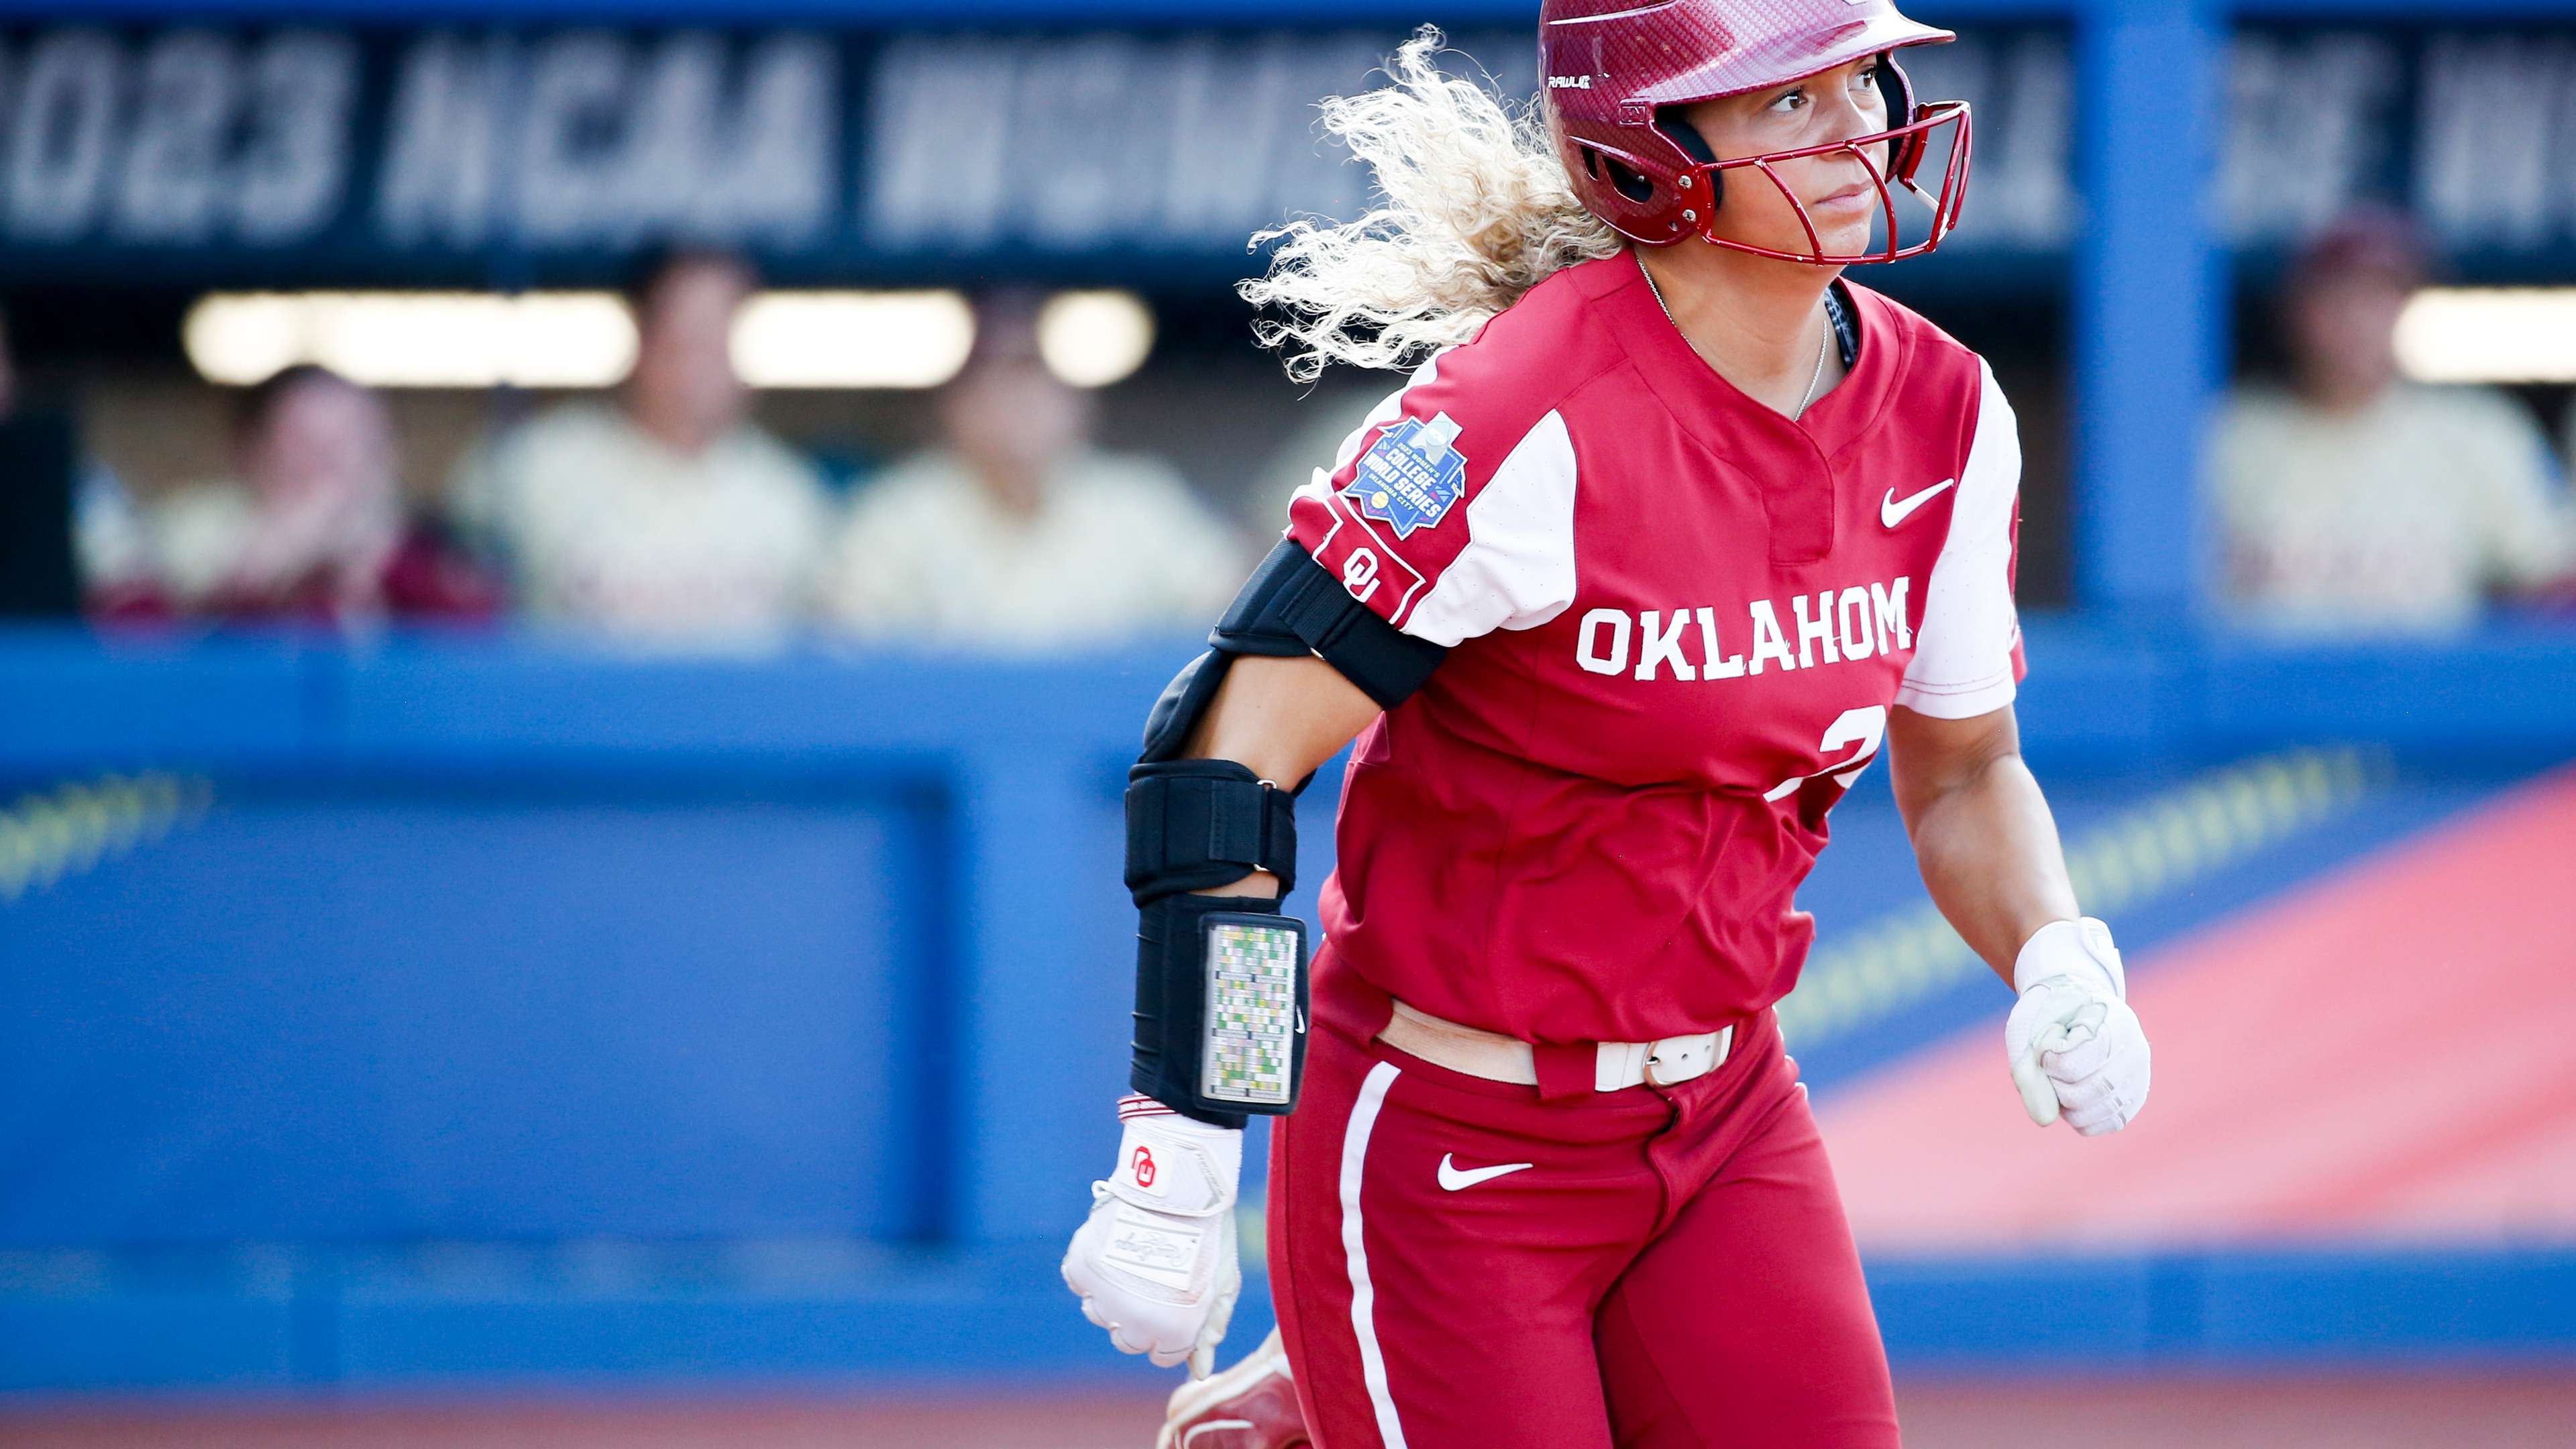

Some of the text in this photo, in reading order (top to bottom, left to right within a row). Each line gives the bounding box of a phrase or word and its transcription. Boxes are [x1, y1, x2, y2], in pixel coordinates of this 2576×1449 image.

[0, 30, 350, 238] 023
[1363, 452, 1442, 518] WORLD SERIES
[1368, 473, 1414, 511] OKLAHOMA CITY
[1385, 448, 1437, 490] COLLEGE
[1411, 453, 1440, 478] WOMEN'S
[1342, 547, 1381, 603] OU
[1575, 576, 1913, 681] OKLAHOM
